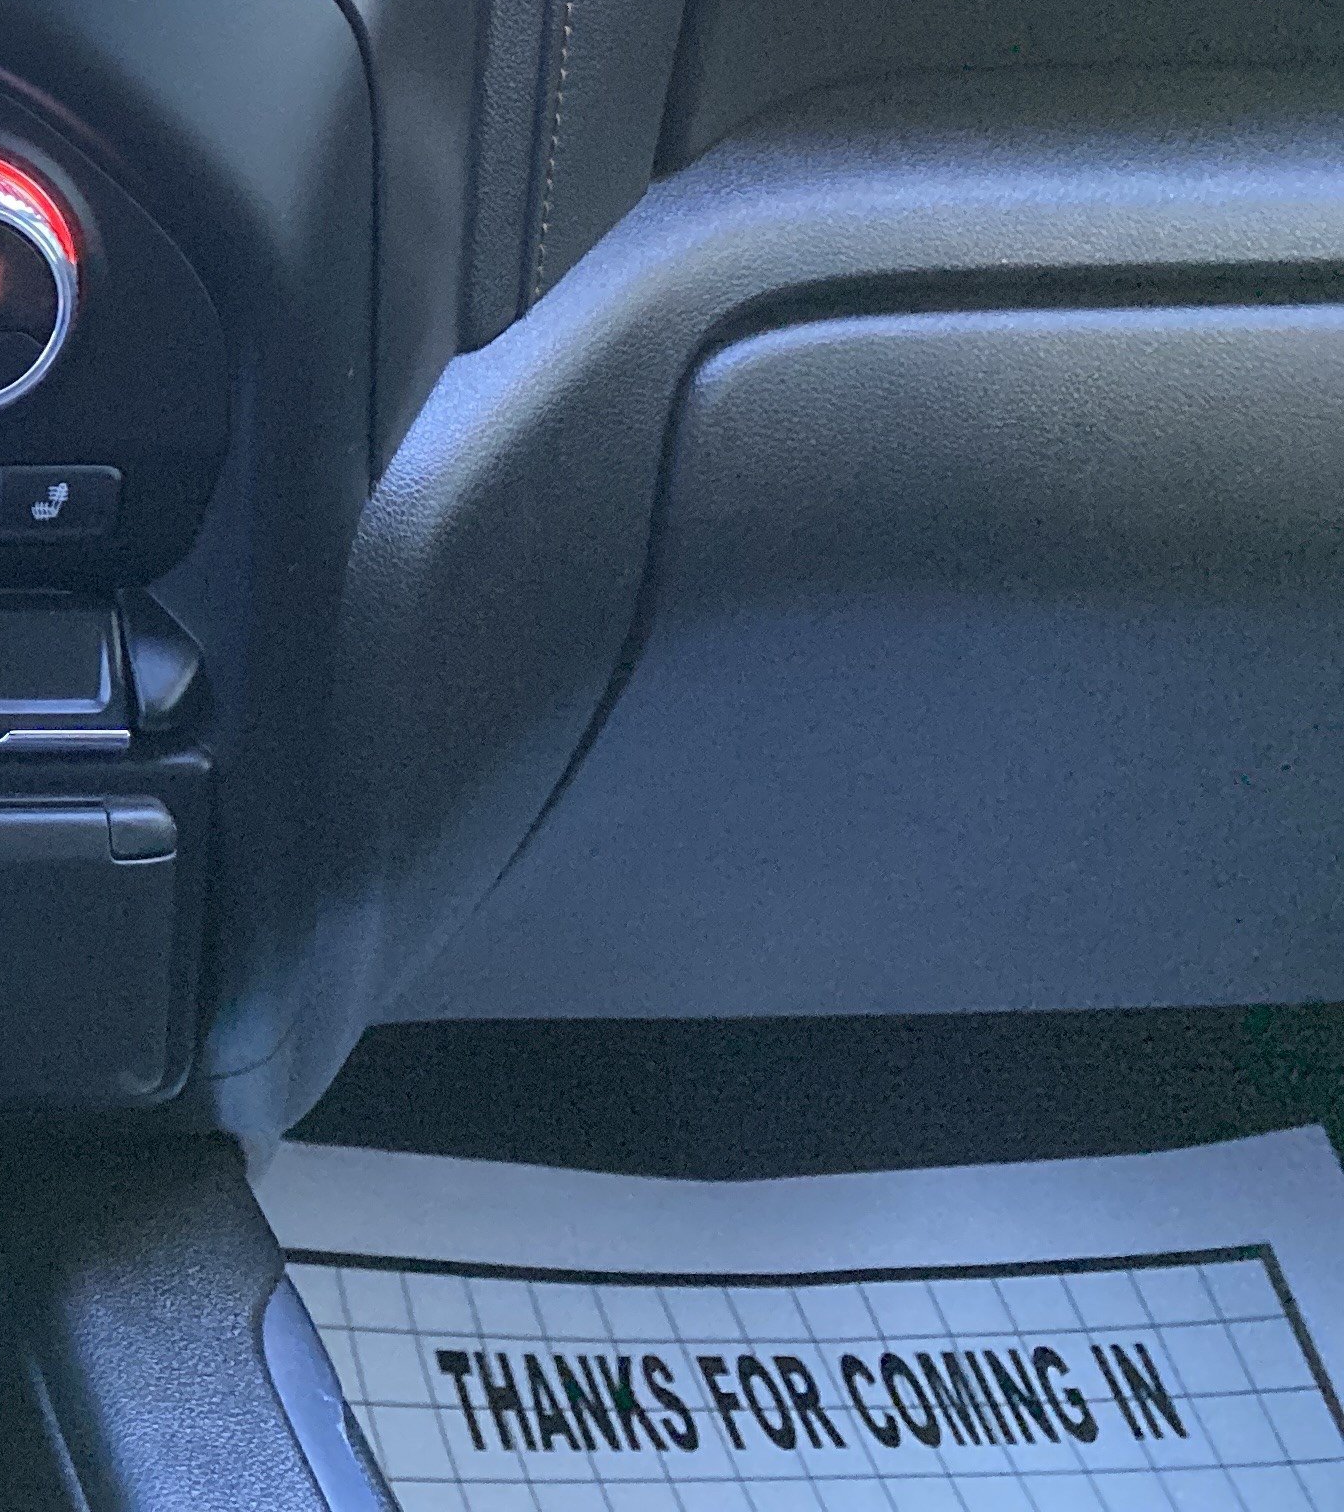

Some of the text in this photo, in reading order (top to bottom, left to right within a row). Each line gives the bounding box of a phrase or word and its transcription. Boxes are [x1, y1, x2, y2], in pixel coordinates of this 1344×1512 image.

[435, 1342, 1190, 1453] THANKS FOR COMING IN
